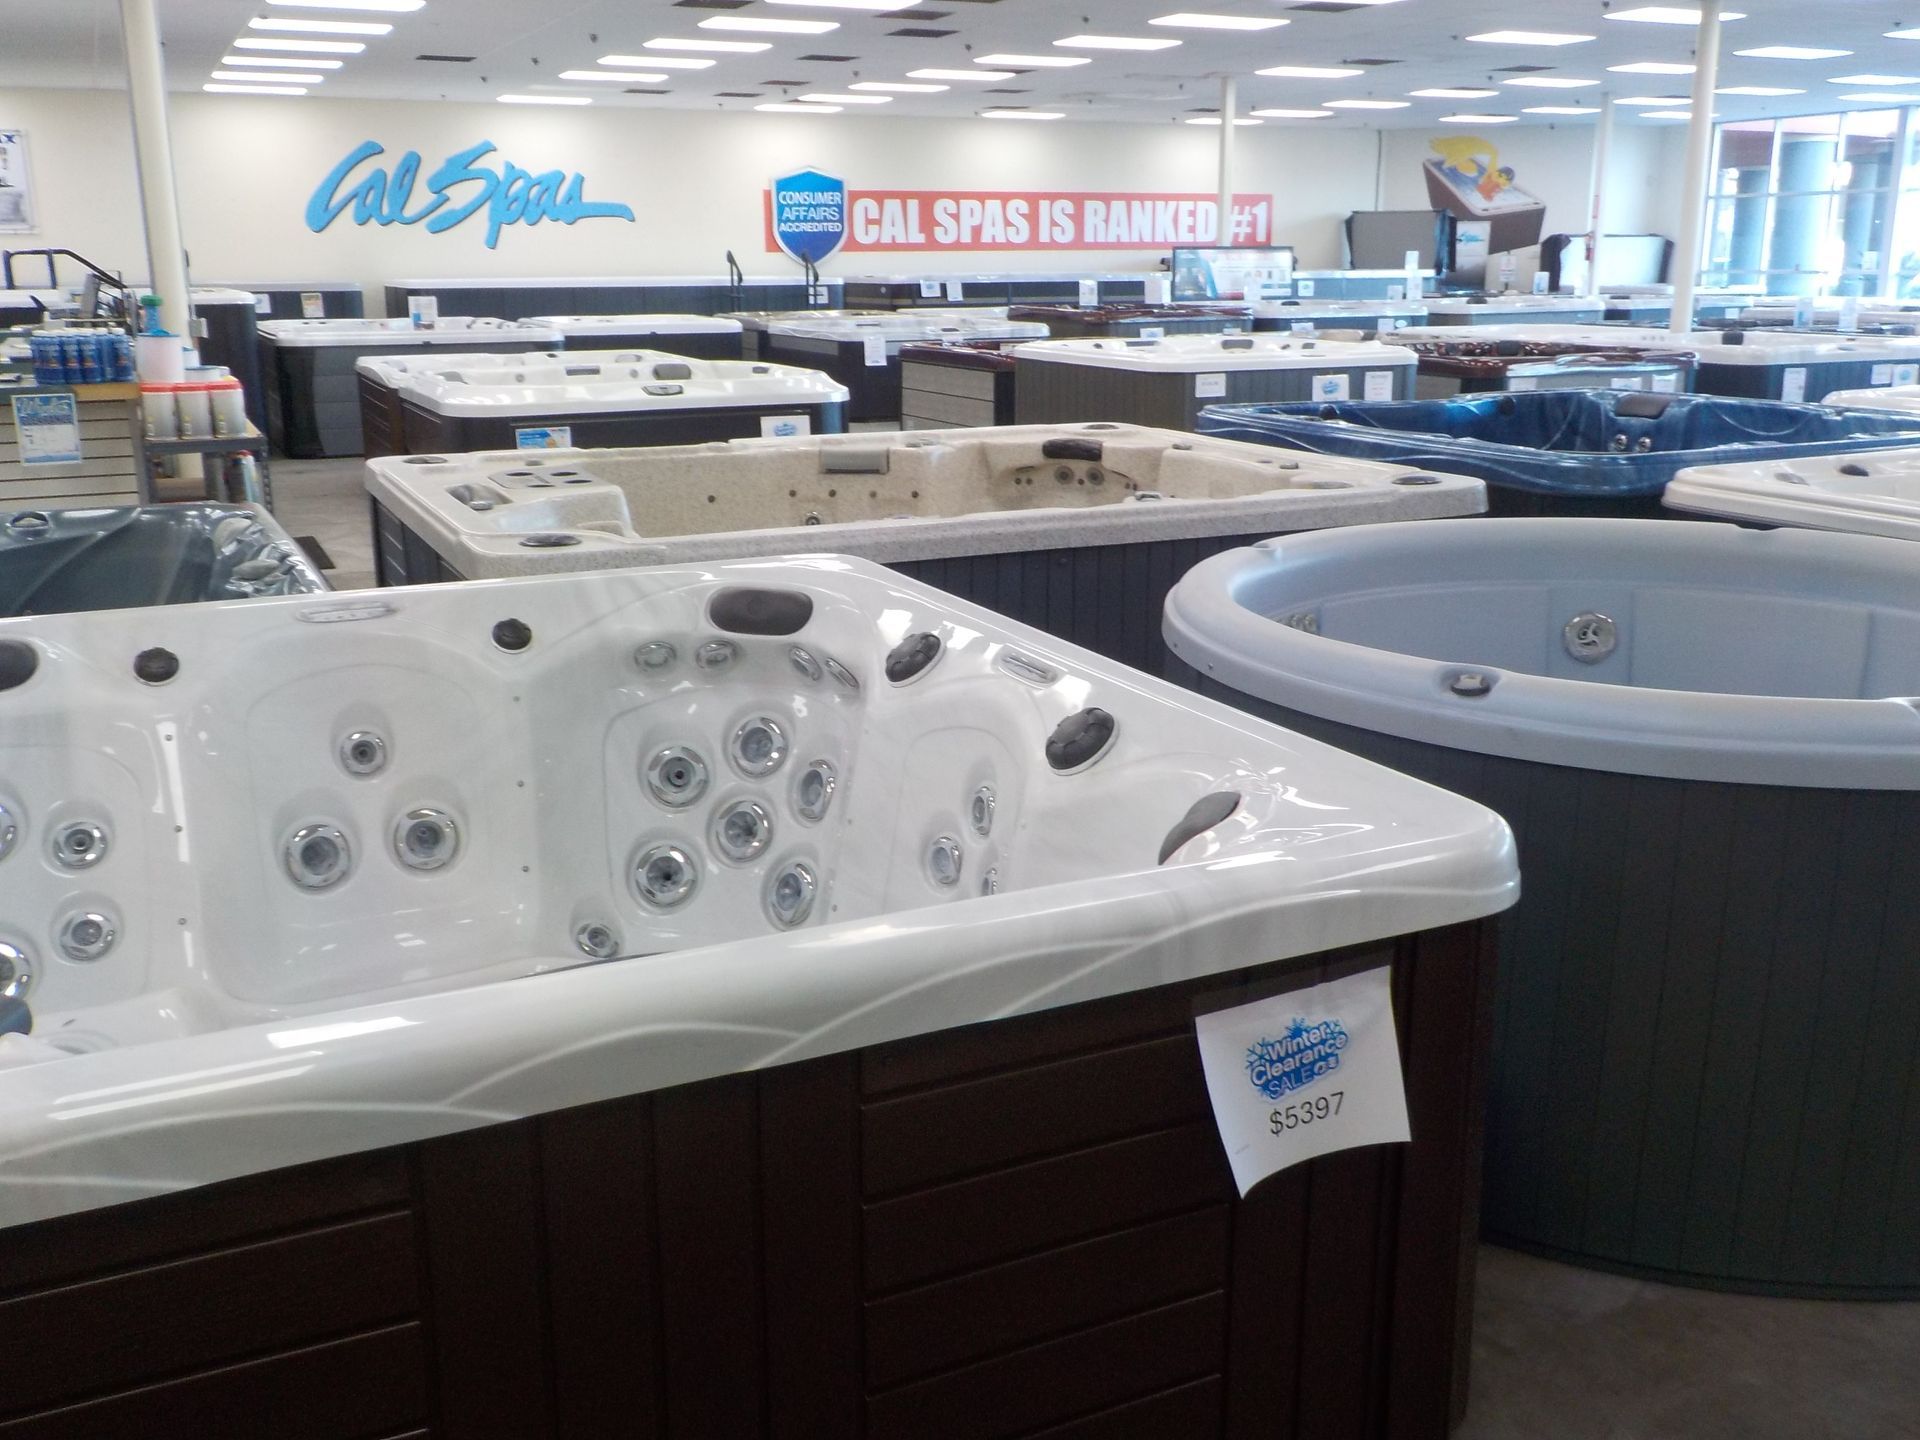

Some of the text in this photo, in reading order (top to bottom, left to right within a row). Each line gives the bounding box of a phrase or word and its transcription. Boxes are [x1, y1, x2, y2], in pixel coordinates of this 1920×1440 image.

[304, 139, 636, 250] Cal Spas
[778, 191, 842, 205] CONSUMER
[781, 206, 840, 221] AFFAIRS
[779, 222, 843, 232] ACCREDITED
[852, 197, 1268, 245] CAL SPAS IS RANKED #1
[1251, 1034, 1347, 1086] Clearance
[1267, 1023, 1329, 1061] Winter
[1268, 1065, 1315, 1098] SALE
[1270, 1091, 1344, 1137] $5397
